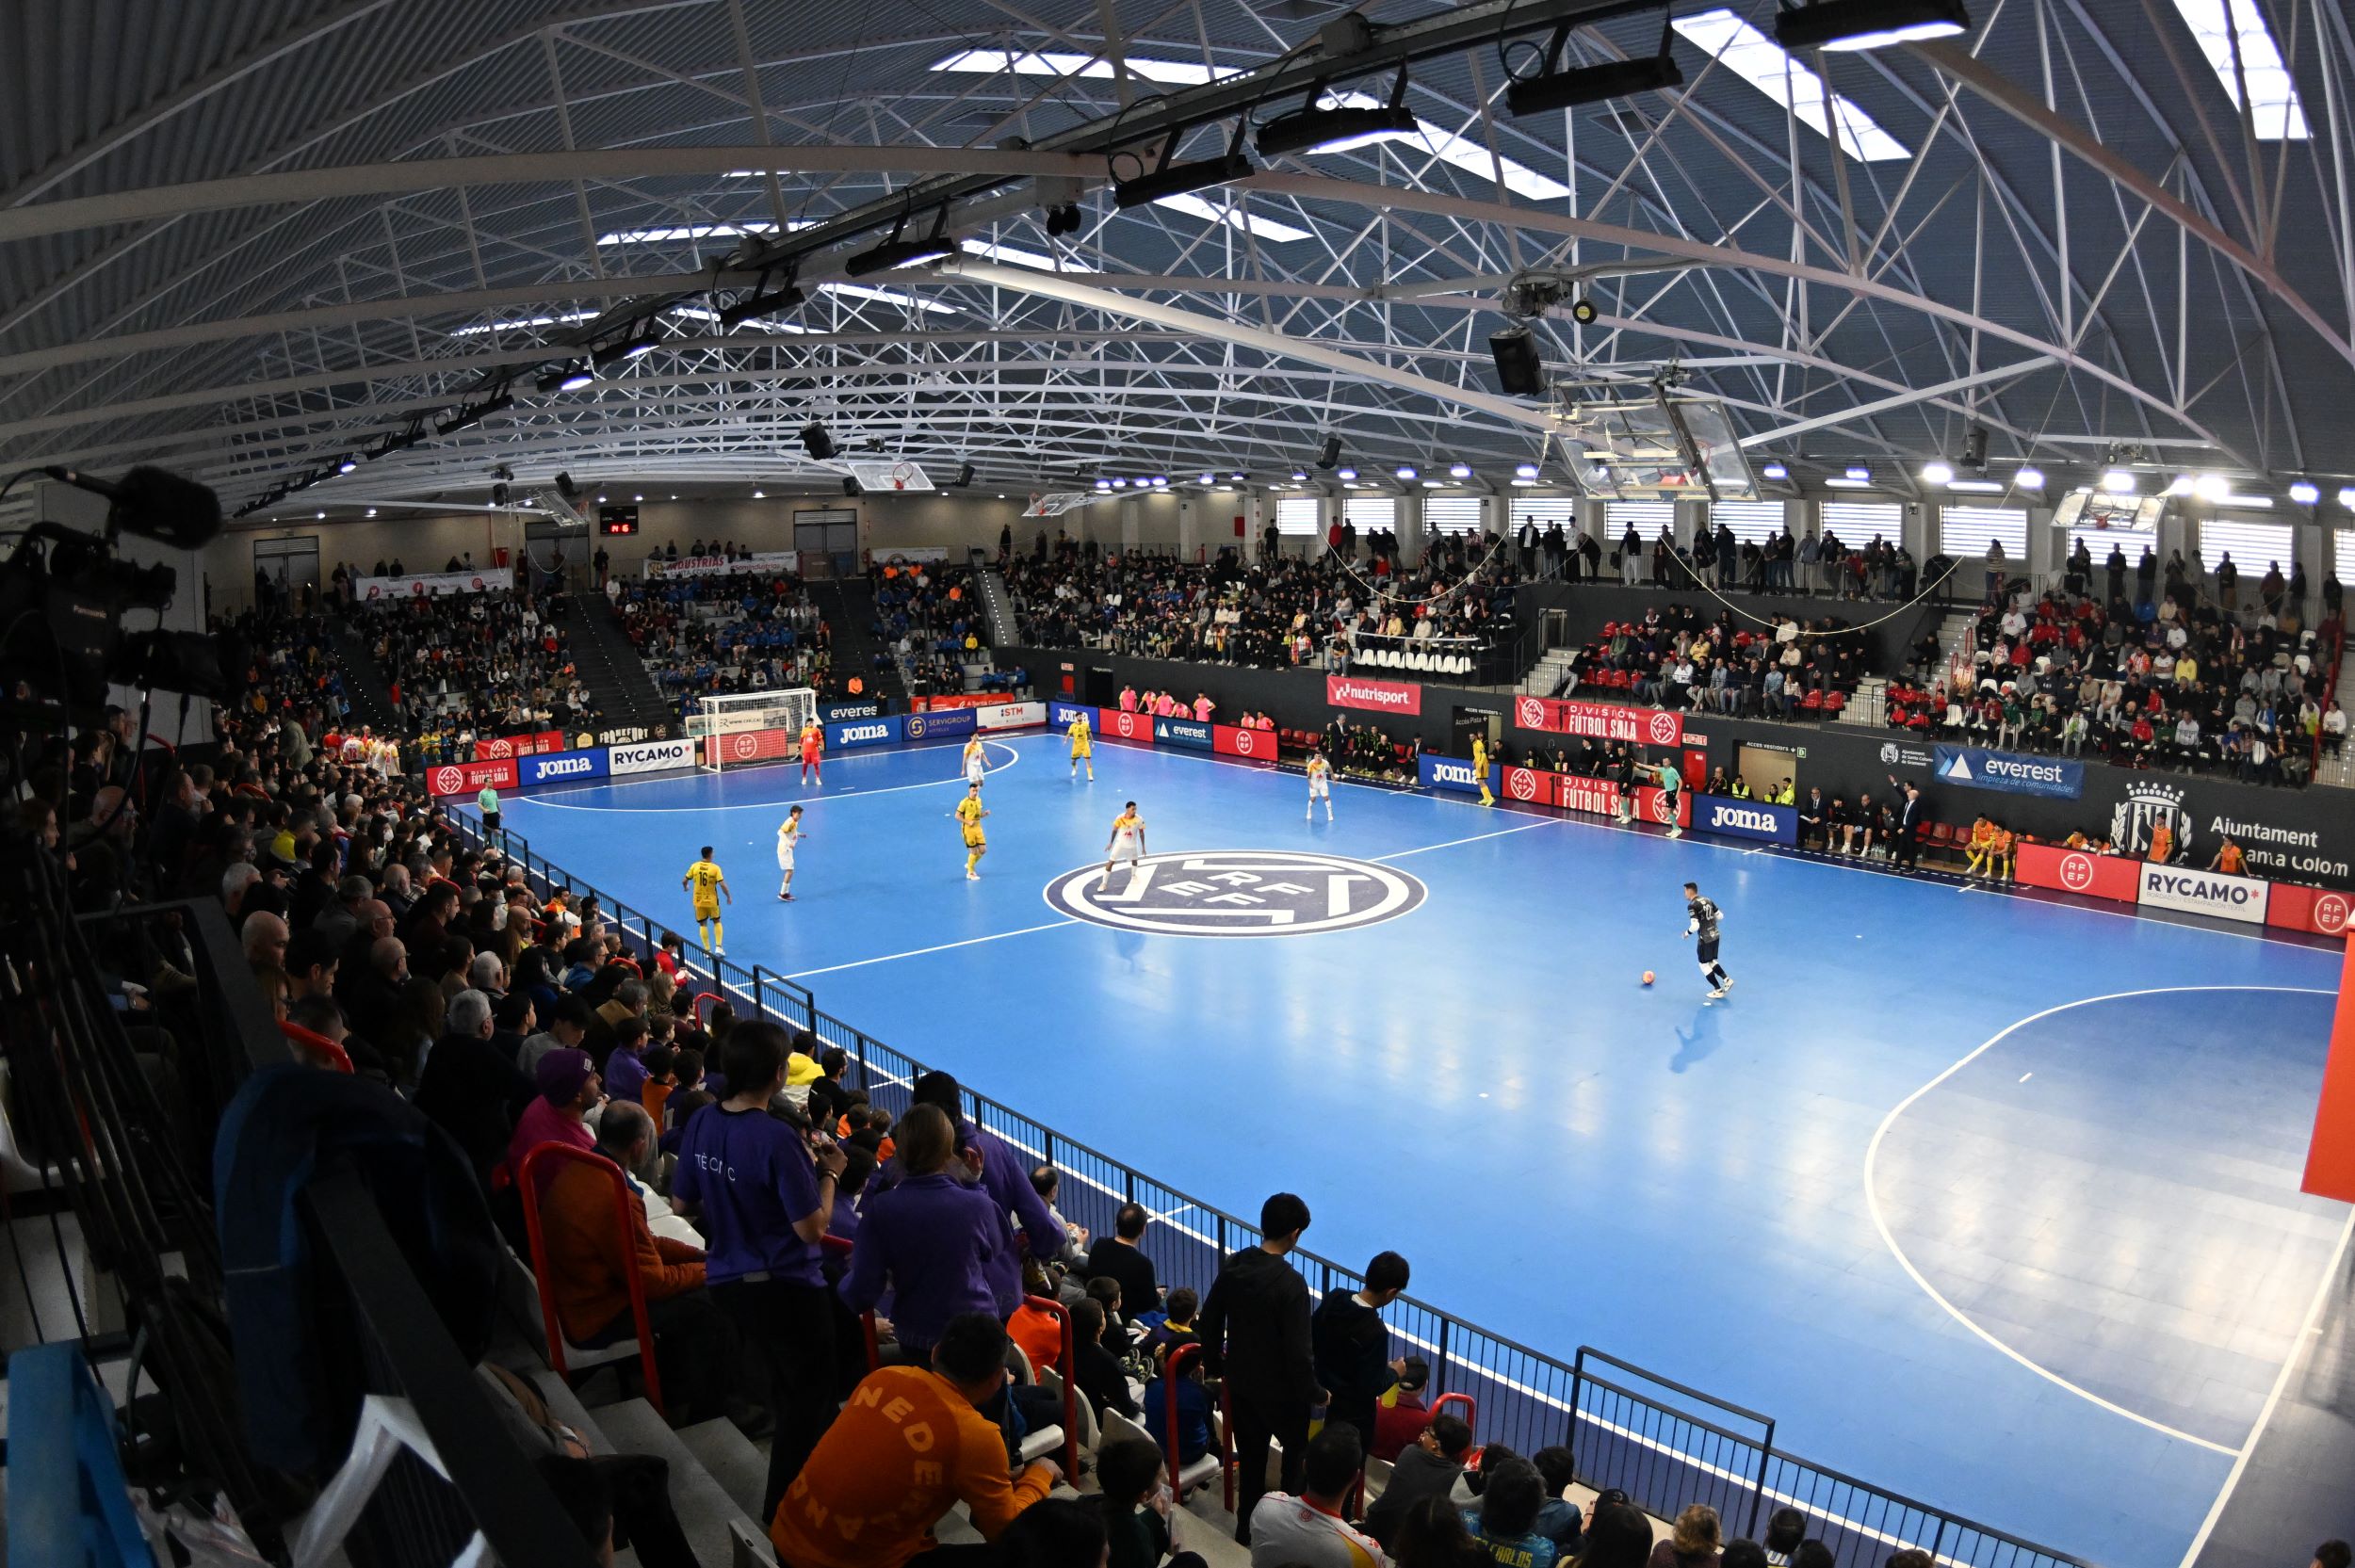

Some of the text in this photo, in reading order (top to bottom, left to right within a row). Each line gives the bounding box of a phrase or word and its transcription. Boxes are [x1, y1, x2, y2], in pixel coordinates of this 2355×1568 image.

[1351, 687, 1409, 704] nutrisport
[830, 705, 878, 719] everes
[1004, 706, 1023, 717] STM
[1570, 705, 1636, 719] DIVISIÓN
[928, 716, 971, 726] SERVIGROUP
[1568, 713, 1637, 739] FÚTBOL SALA
[599, 727, 649, 744] FRANKFURT
[1173, 725, 1207, 739] everest
[614, 746, 683, 765] RYCAMO
[494, 772, 509, 783] SALA
[1985, 760, 2063, 784] everest
[2010, 777, 2021, 786] de
[2022, 781, 2075, 794] comunidades
[1563, 785, 1607, 815] FÚTBOL
[699, 871, 707, 886] 16
[2147, 873, 2249, 905] RYCAMO
